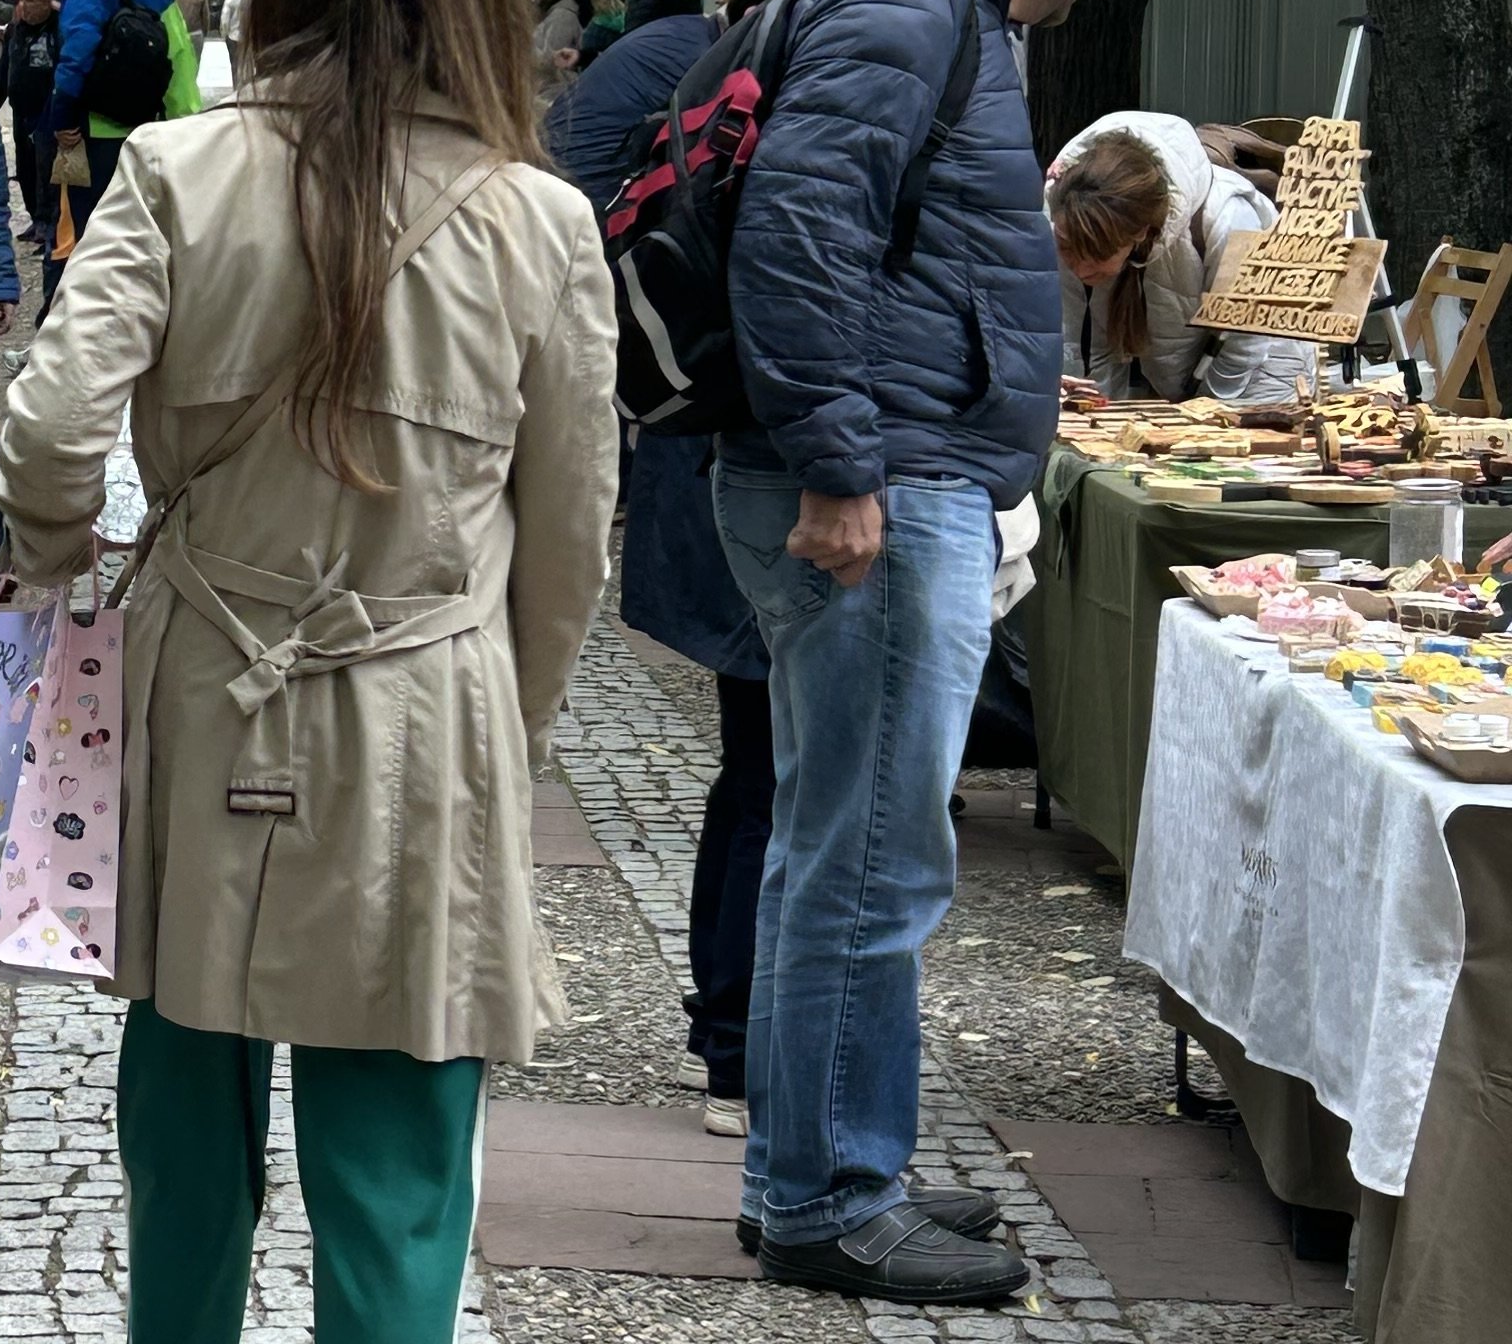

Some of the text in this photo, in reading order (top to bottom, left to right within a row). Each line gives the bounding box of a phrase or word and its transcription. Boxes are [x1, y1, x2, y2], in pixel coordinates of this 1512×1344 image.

[1298, 116, 1360, 150] ВЯРА
[1282, 145, 1372, 182] РАДОСТ
[1276, 176, 1365, 211] ЩАСТИЕ
[1272, 206, 1345, 238] ЛЮБОВ
